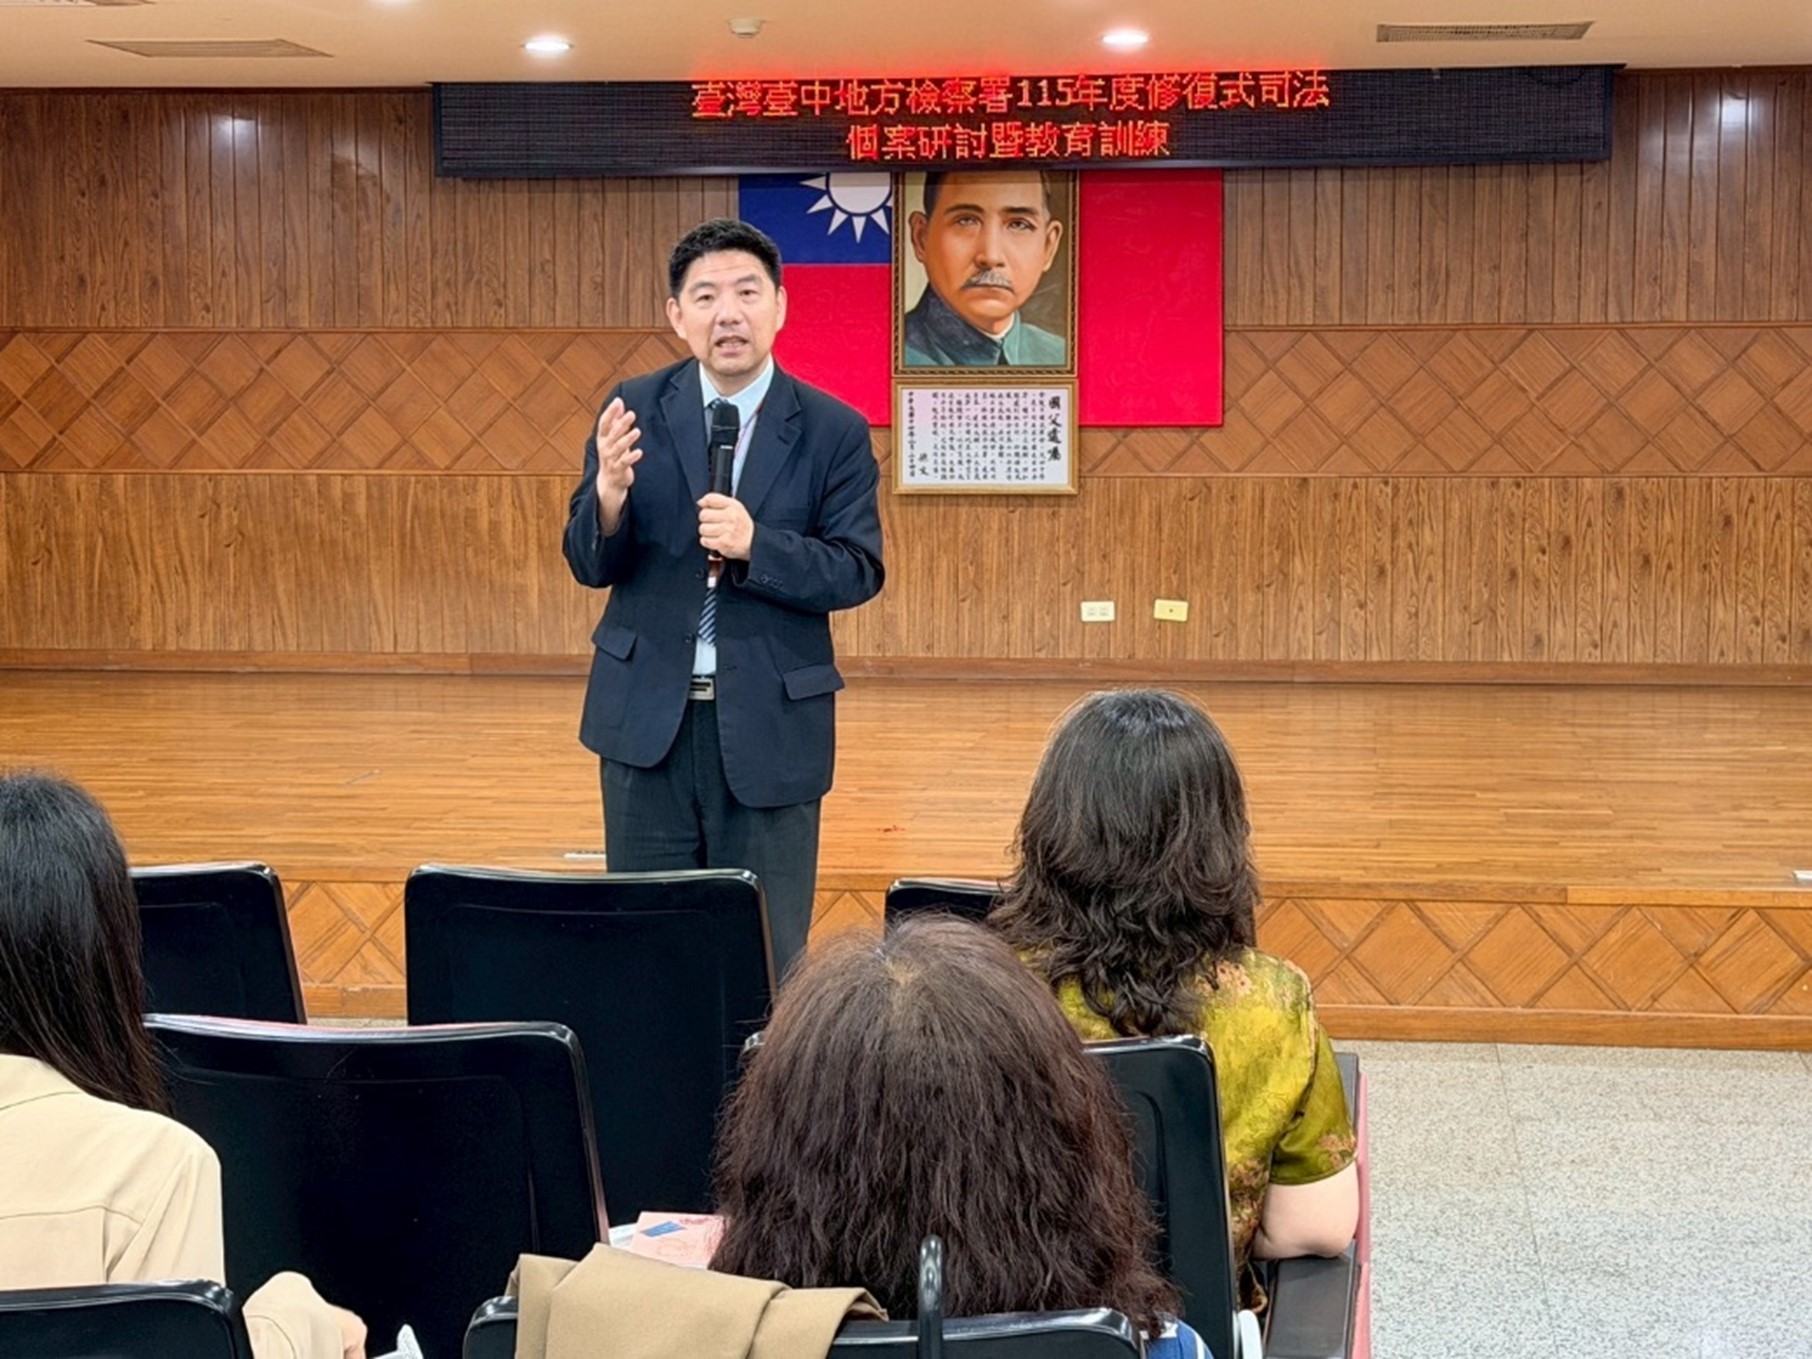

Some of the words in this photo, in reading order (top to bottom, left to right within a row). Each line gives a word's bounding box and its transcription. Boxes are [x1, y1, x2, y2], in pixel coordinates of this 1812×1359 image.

[691, 70, 1331, 117] 臺灣臺中地方檢察署115年度修復式司法
[846, 120, 1171, 160] 個案研討暨教育訓練
